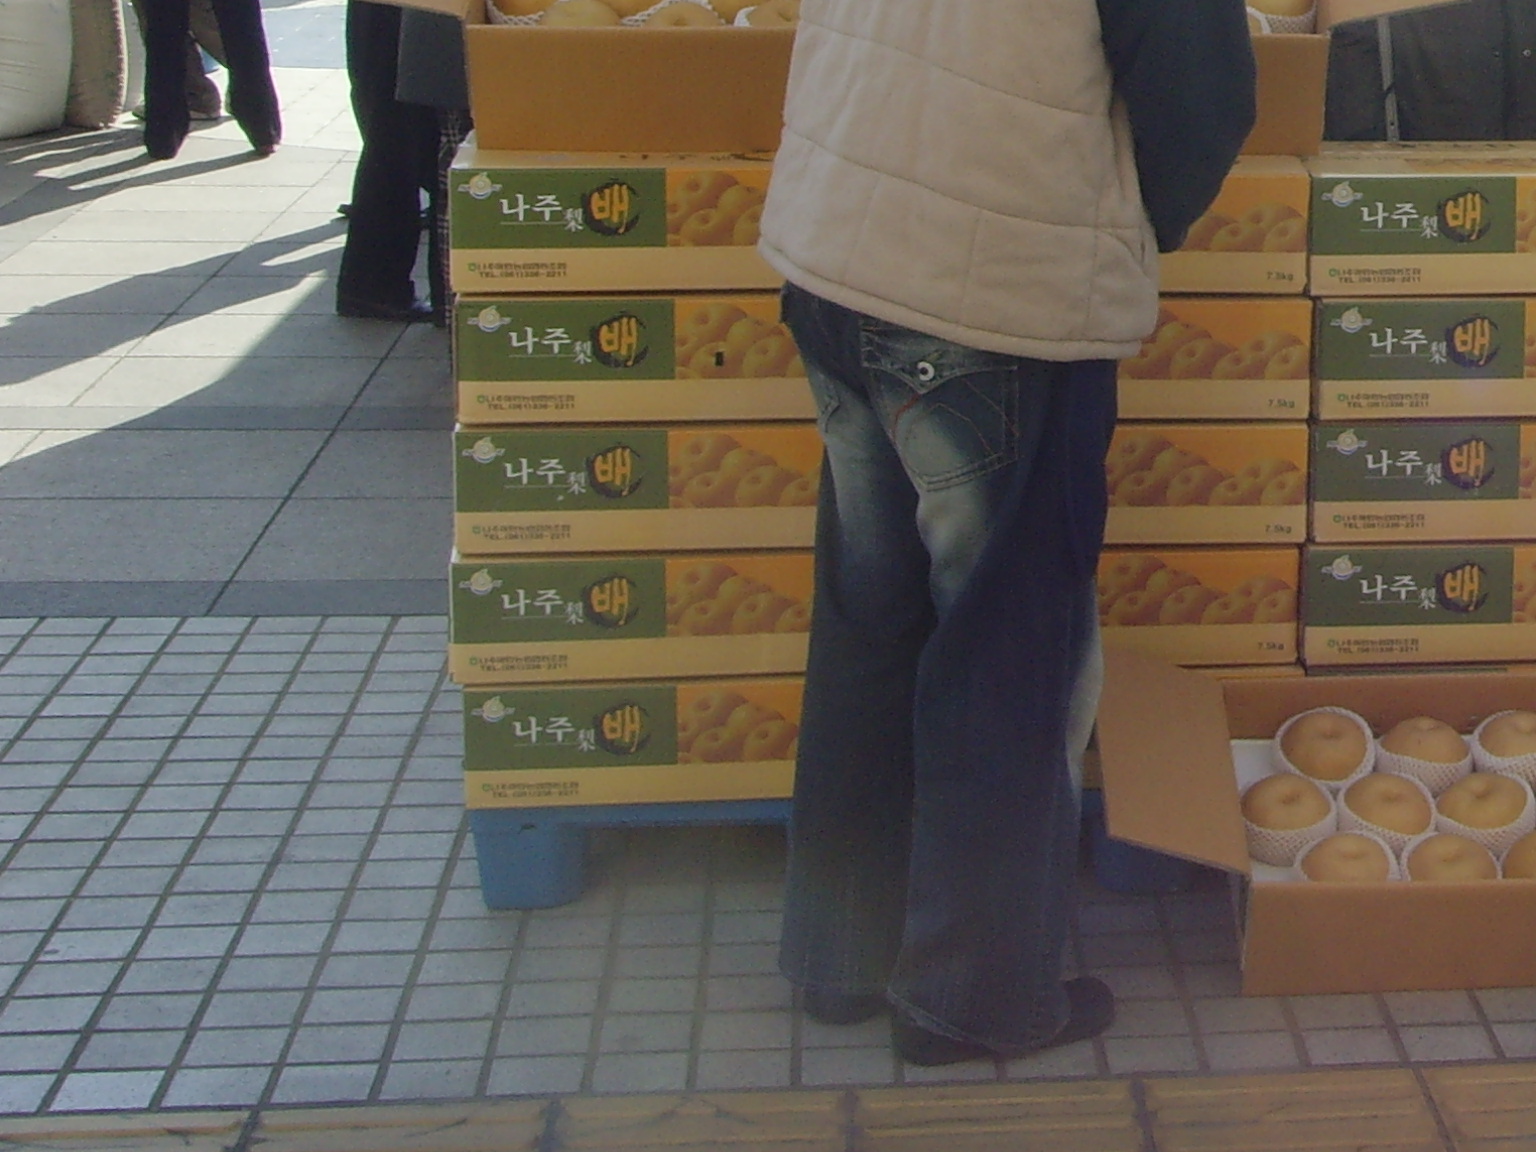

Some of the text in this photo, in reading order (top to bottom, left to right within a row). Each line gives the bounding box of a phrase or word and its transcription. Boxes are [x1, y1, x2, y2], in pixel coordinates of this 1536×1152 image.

[499, 192, 563, 222] 나주
[591, 182, 630, 234] 배
[1360, 201, 1418, 229] 나주
[1443, 192, 1478, 239] 배
[509, 325, 571, 355] 나주
[598, 316, 636, 366] 배
[1369, 327, 1427, 355] 나주
[1452, 318, 1487, 365] 배
[504, 457, 564, 486] 나주
[590, 448, 627, 496] 배
[1364, 448, 1422, 475] 나주
[1447, 439, 1482, 486] 배
[501, 588, 564, 616] 나주
[591, 578, 630, 629] 배
[1358, 573, 1417, 600] 나주
[1443, 564, 1478, 612] 배
[514, 715, 574, 743] 나주
[600, 706, 637, 754] 배
